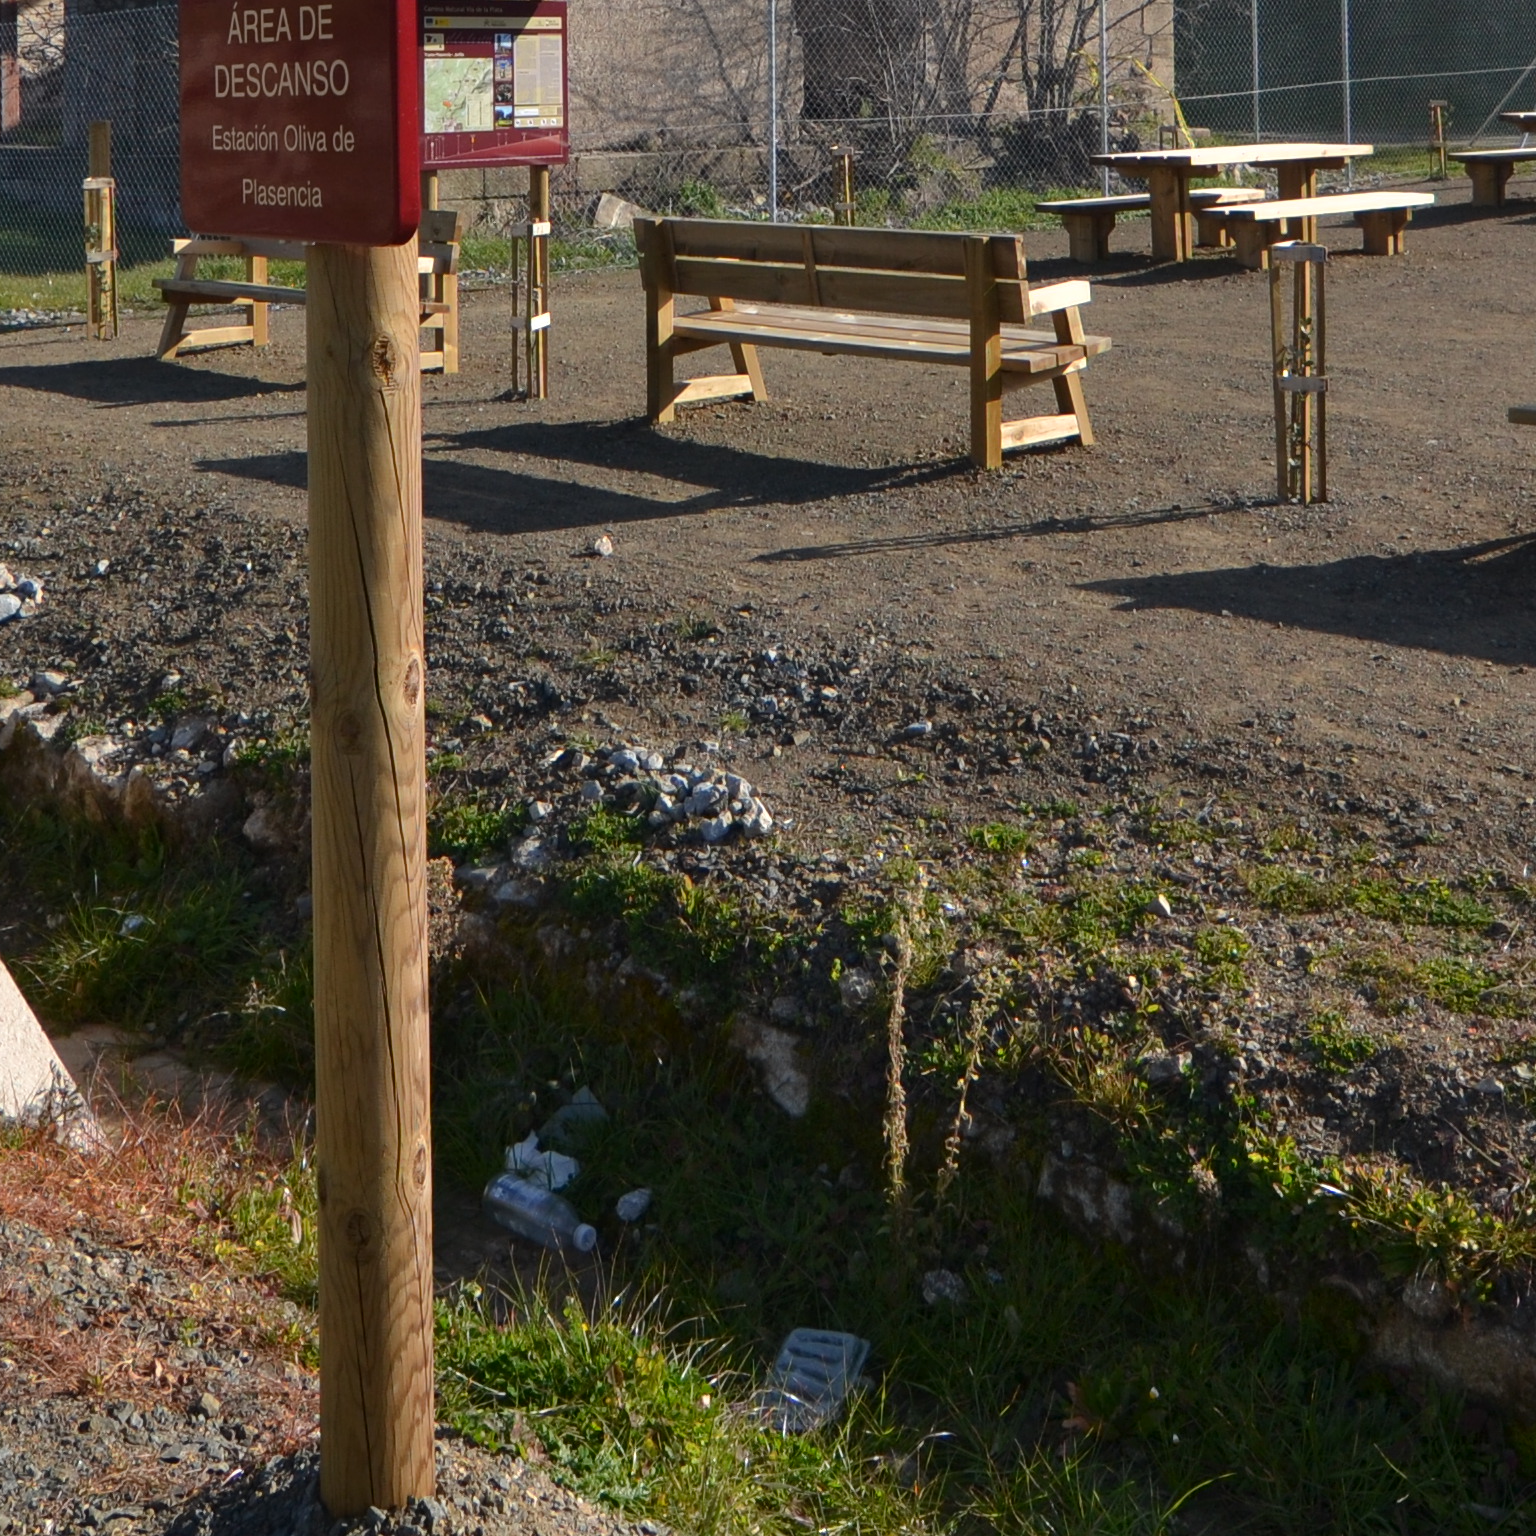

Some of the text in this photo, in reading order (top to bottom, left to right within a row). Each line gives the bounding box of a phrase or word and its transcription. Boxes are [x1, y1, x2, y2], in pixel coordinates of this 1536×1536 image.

[227, 1, 334, 44] ÁREA DE
[214, 59, 350, 98] DESCANSO
[212, 124, 355, 152] Estación Oliva de
[242, 178, 322, 208] Plasencia
